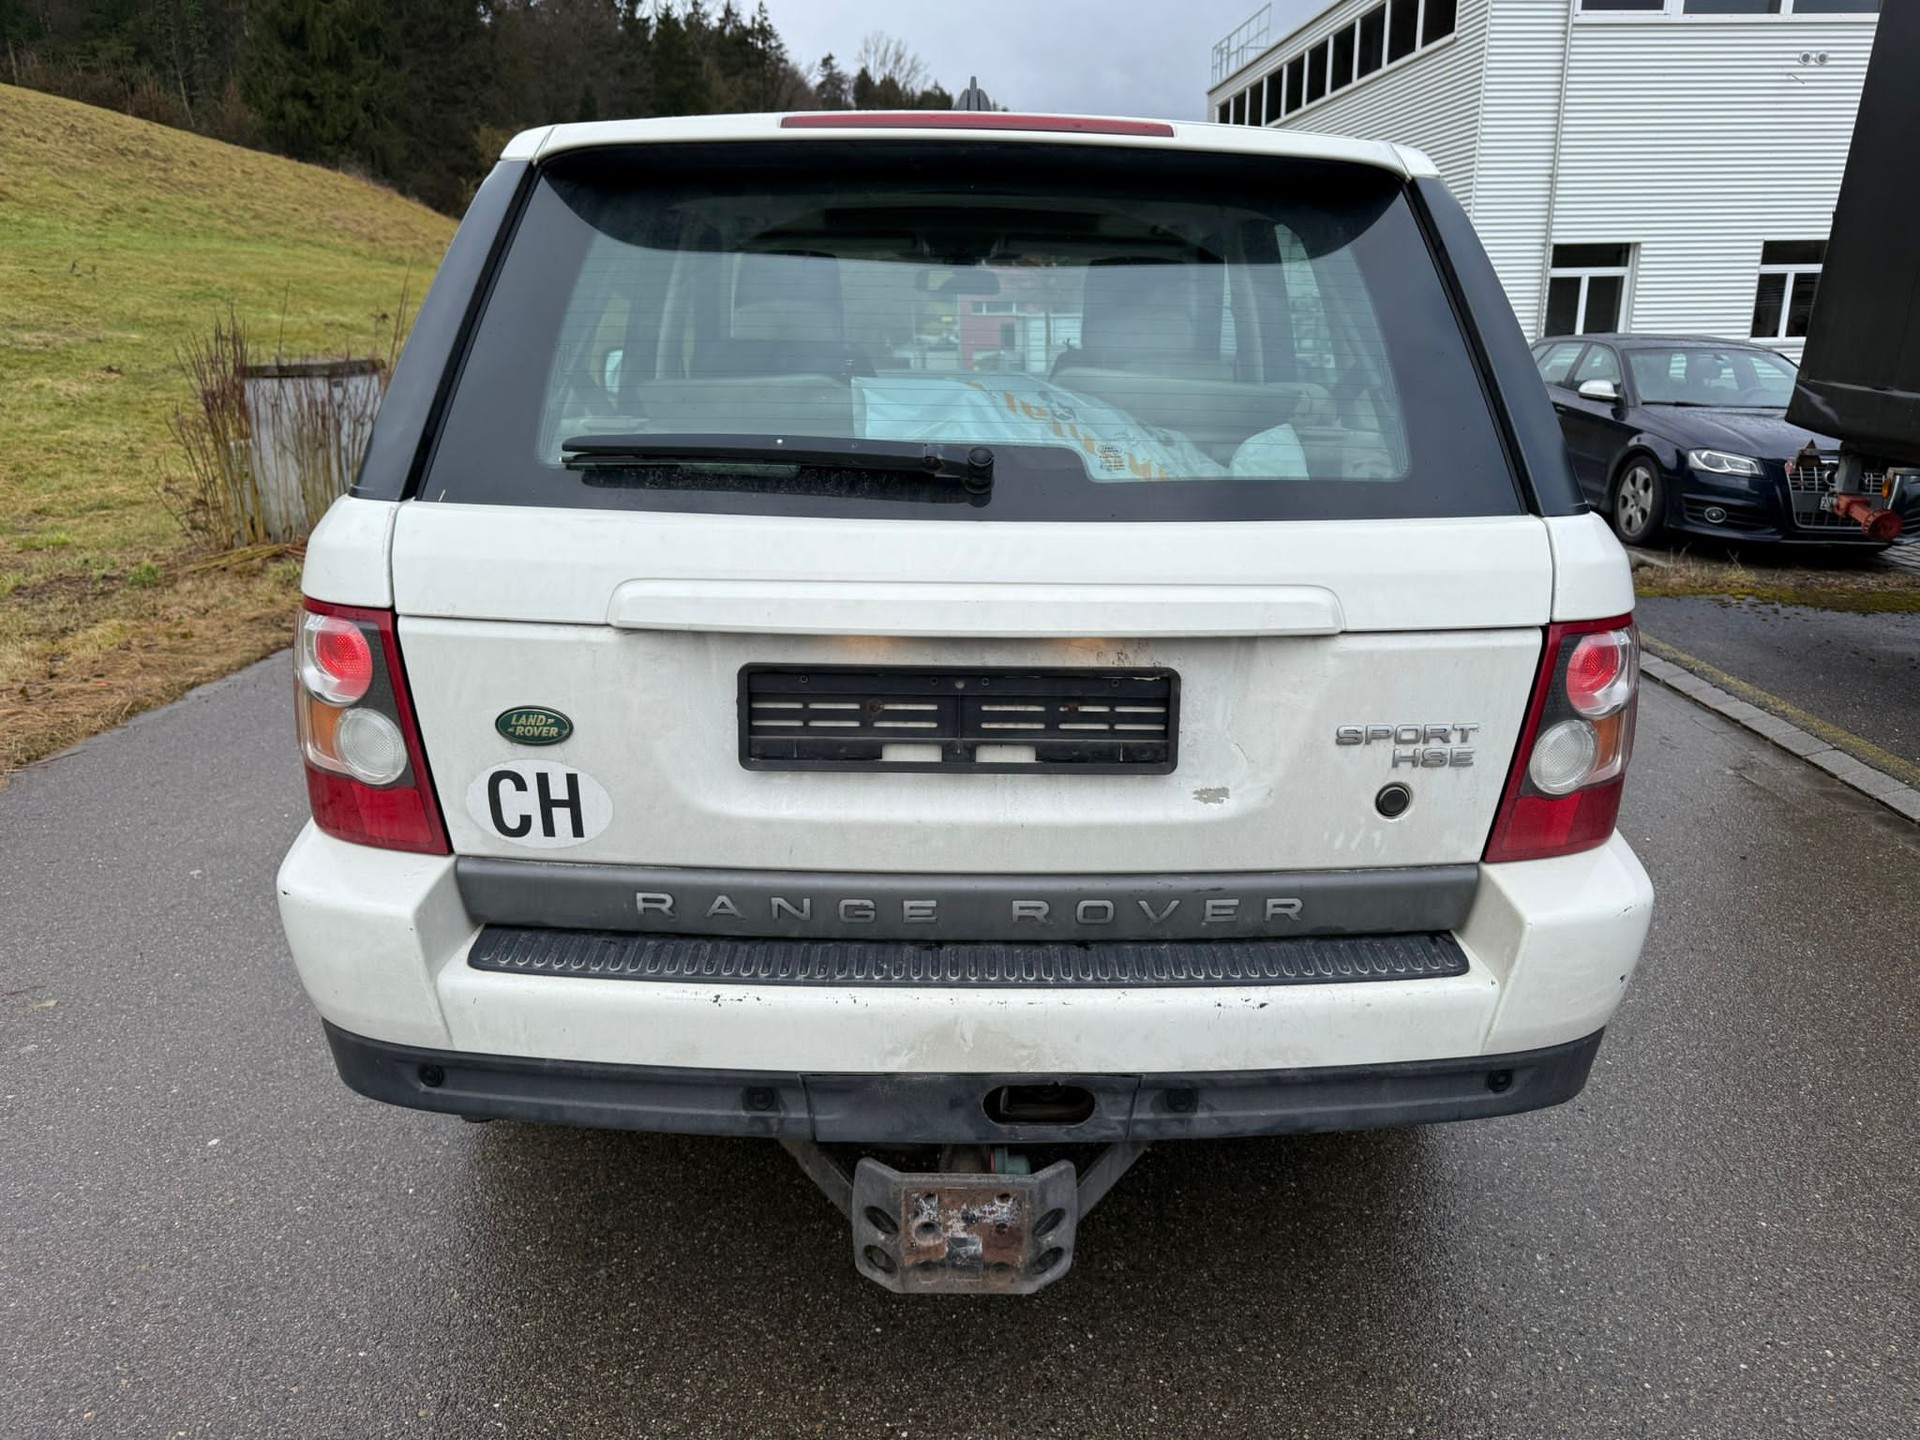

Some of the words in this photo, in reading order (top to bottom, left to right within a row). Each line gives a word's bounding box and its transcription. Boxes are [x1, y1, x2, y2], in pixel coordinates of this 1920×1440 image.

[511, 714, 546, 726] LAND
[515, 726, 559, 737] ROVER
[1335, 723, 1480, 746] SPORT
[1391, 746, 1475, 768] HSE
[487, 769, 585, 838] CH
[635, 891, 939, 923] RANGE
[1011, 898, 1304, 924] ROVER
